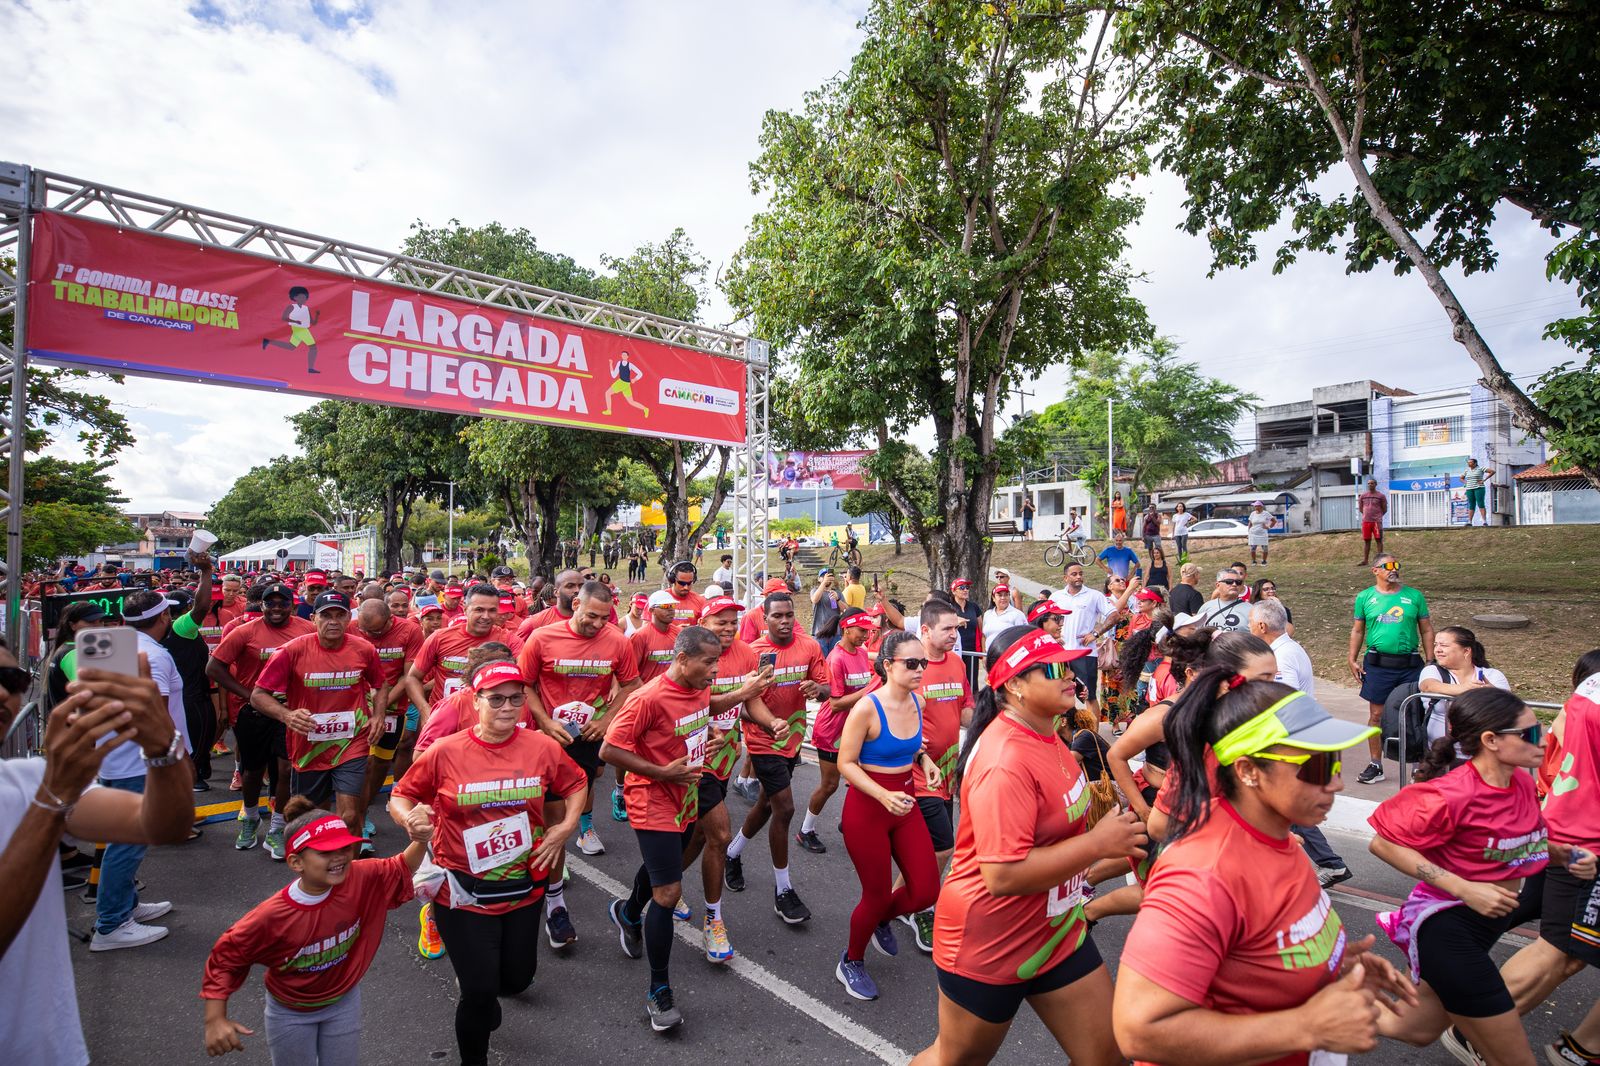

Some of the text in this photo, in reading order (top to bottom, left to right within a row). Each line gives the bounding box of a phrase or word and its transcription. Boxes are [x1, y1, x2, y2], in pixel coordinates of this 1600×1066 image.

[75, 268, 152, 296] CORRIDA
[154, 282, 177, 300] DA
[180, 288, 239, 311] CLASSE
[51, 280, 240, 330] TRABALHADORA
[107, 310, 192, 330] DE CAMAÇARI
[350, 290, 589, 371] LARGADA
[348, 343, 589, 414] CHEGADA
[664, 388, 714, 404] CAMAÇARI
[320, 723, 344, 734] 319
[564, 711, 584, 723] 285
[482, 833, 517, 856] 136
